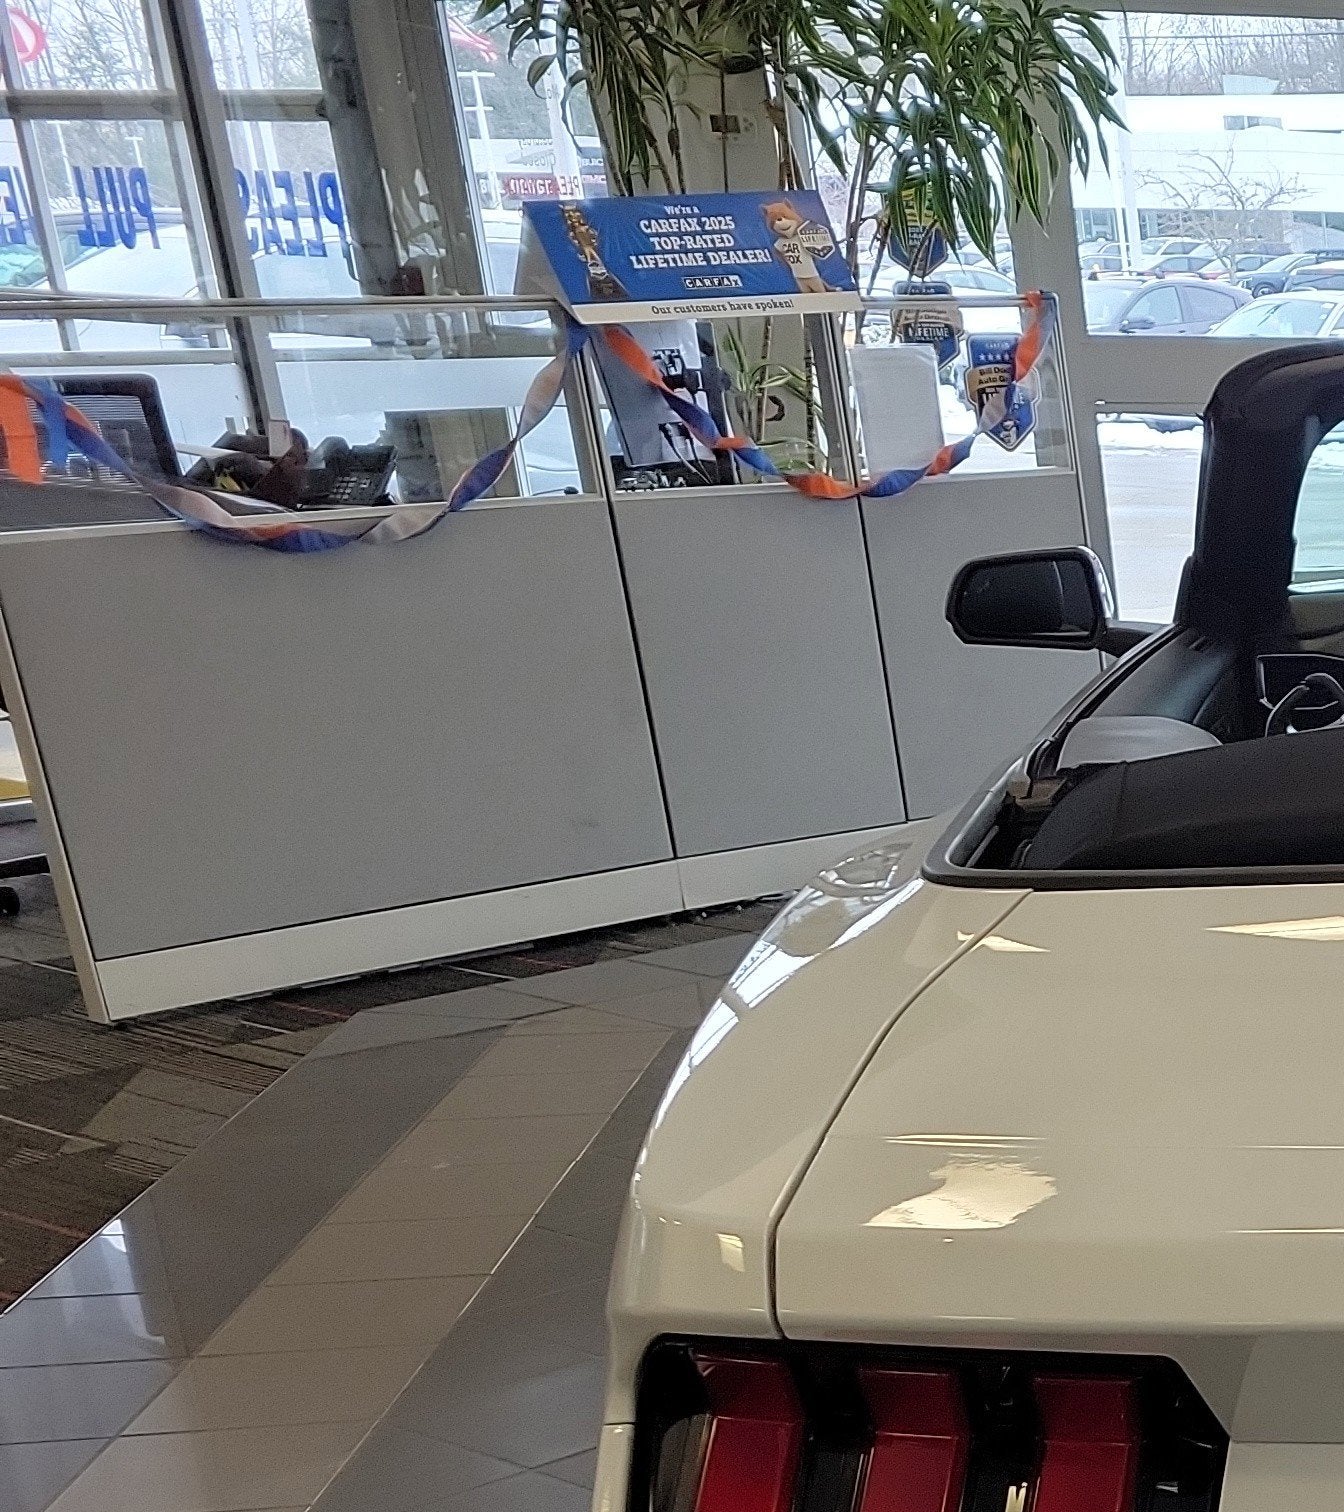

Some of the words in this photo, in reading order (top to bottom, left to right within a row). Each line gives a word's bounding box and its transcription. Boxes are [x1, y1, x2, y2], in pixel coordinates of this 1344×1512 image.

[664, 204, 691, 215] We're
[639, 217, 701, 233] CARFAX
[703, 215, 736, 231] 2025
[649, 233, 735, 251] TOP-RATED
[629, 251, 708, 269] LIFETIME
[709, 248, 773, 266] DEALER!
[685, 276, 741, 289] CARFAX
[651, 303, 671, 315] Our
[673, 302, 727, 314] customers
[729, 300, 753, 312] have
[754, 298, 795, 313] spoken!
[908, 327, 949, 337] LFETIME
